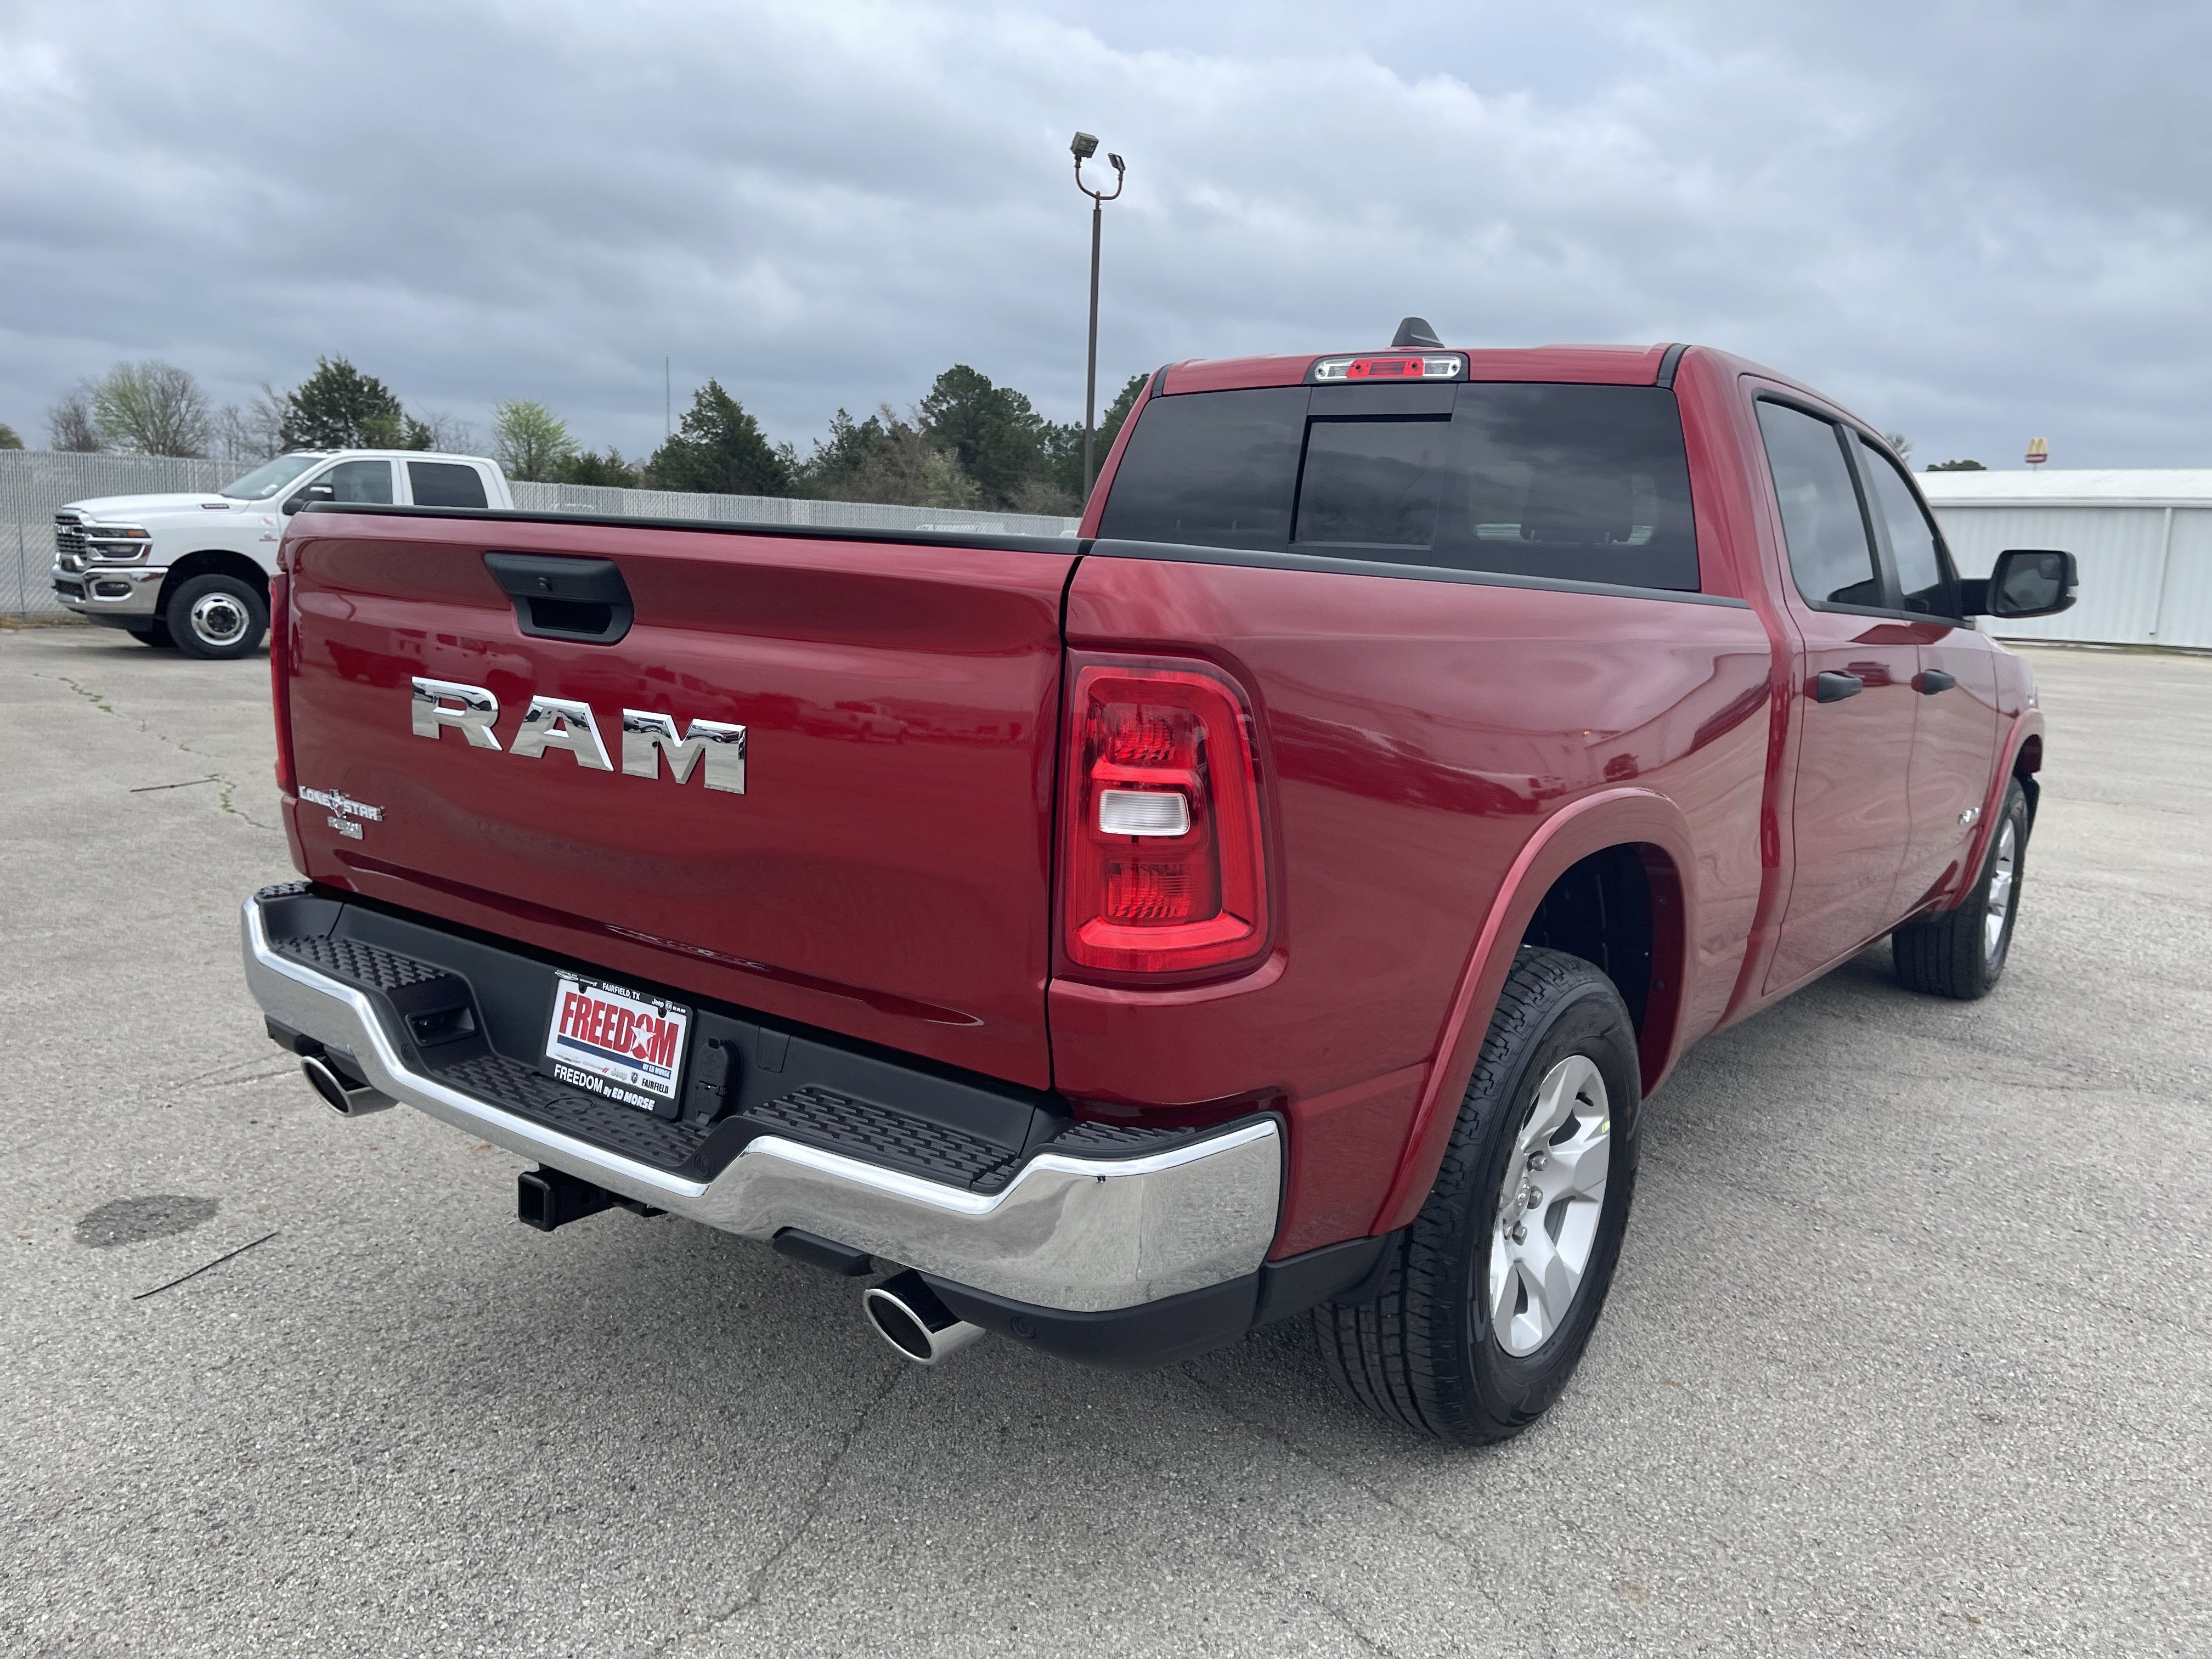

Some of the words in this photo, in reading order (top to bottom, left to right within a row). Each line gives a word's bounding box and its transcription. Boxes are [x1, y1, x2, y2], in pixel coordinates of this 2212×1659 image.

[411, 676, 746, 794] RAM
[300, 787, 330, 806] LONE
[343, 800, 379, 821] STAR
[602, 983, 631, 999] FAIRFIELD,
[632, 991, 641, 1001] TX
[651, 998, 664, 1008] Jeep
[673, 1006, 686, 1014] RAM
[558, 991, 679, 1068] FREEDOM
[611, 1067, 627, 1081] Jeep
[554, 1064, 603, 1093] FREEDOM
[611, 1087, 624, 1100] ED
[623, 1091, 656, 1111] MORSE
[641, 1078, 669, 1094] FAIRFIELD
